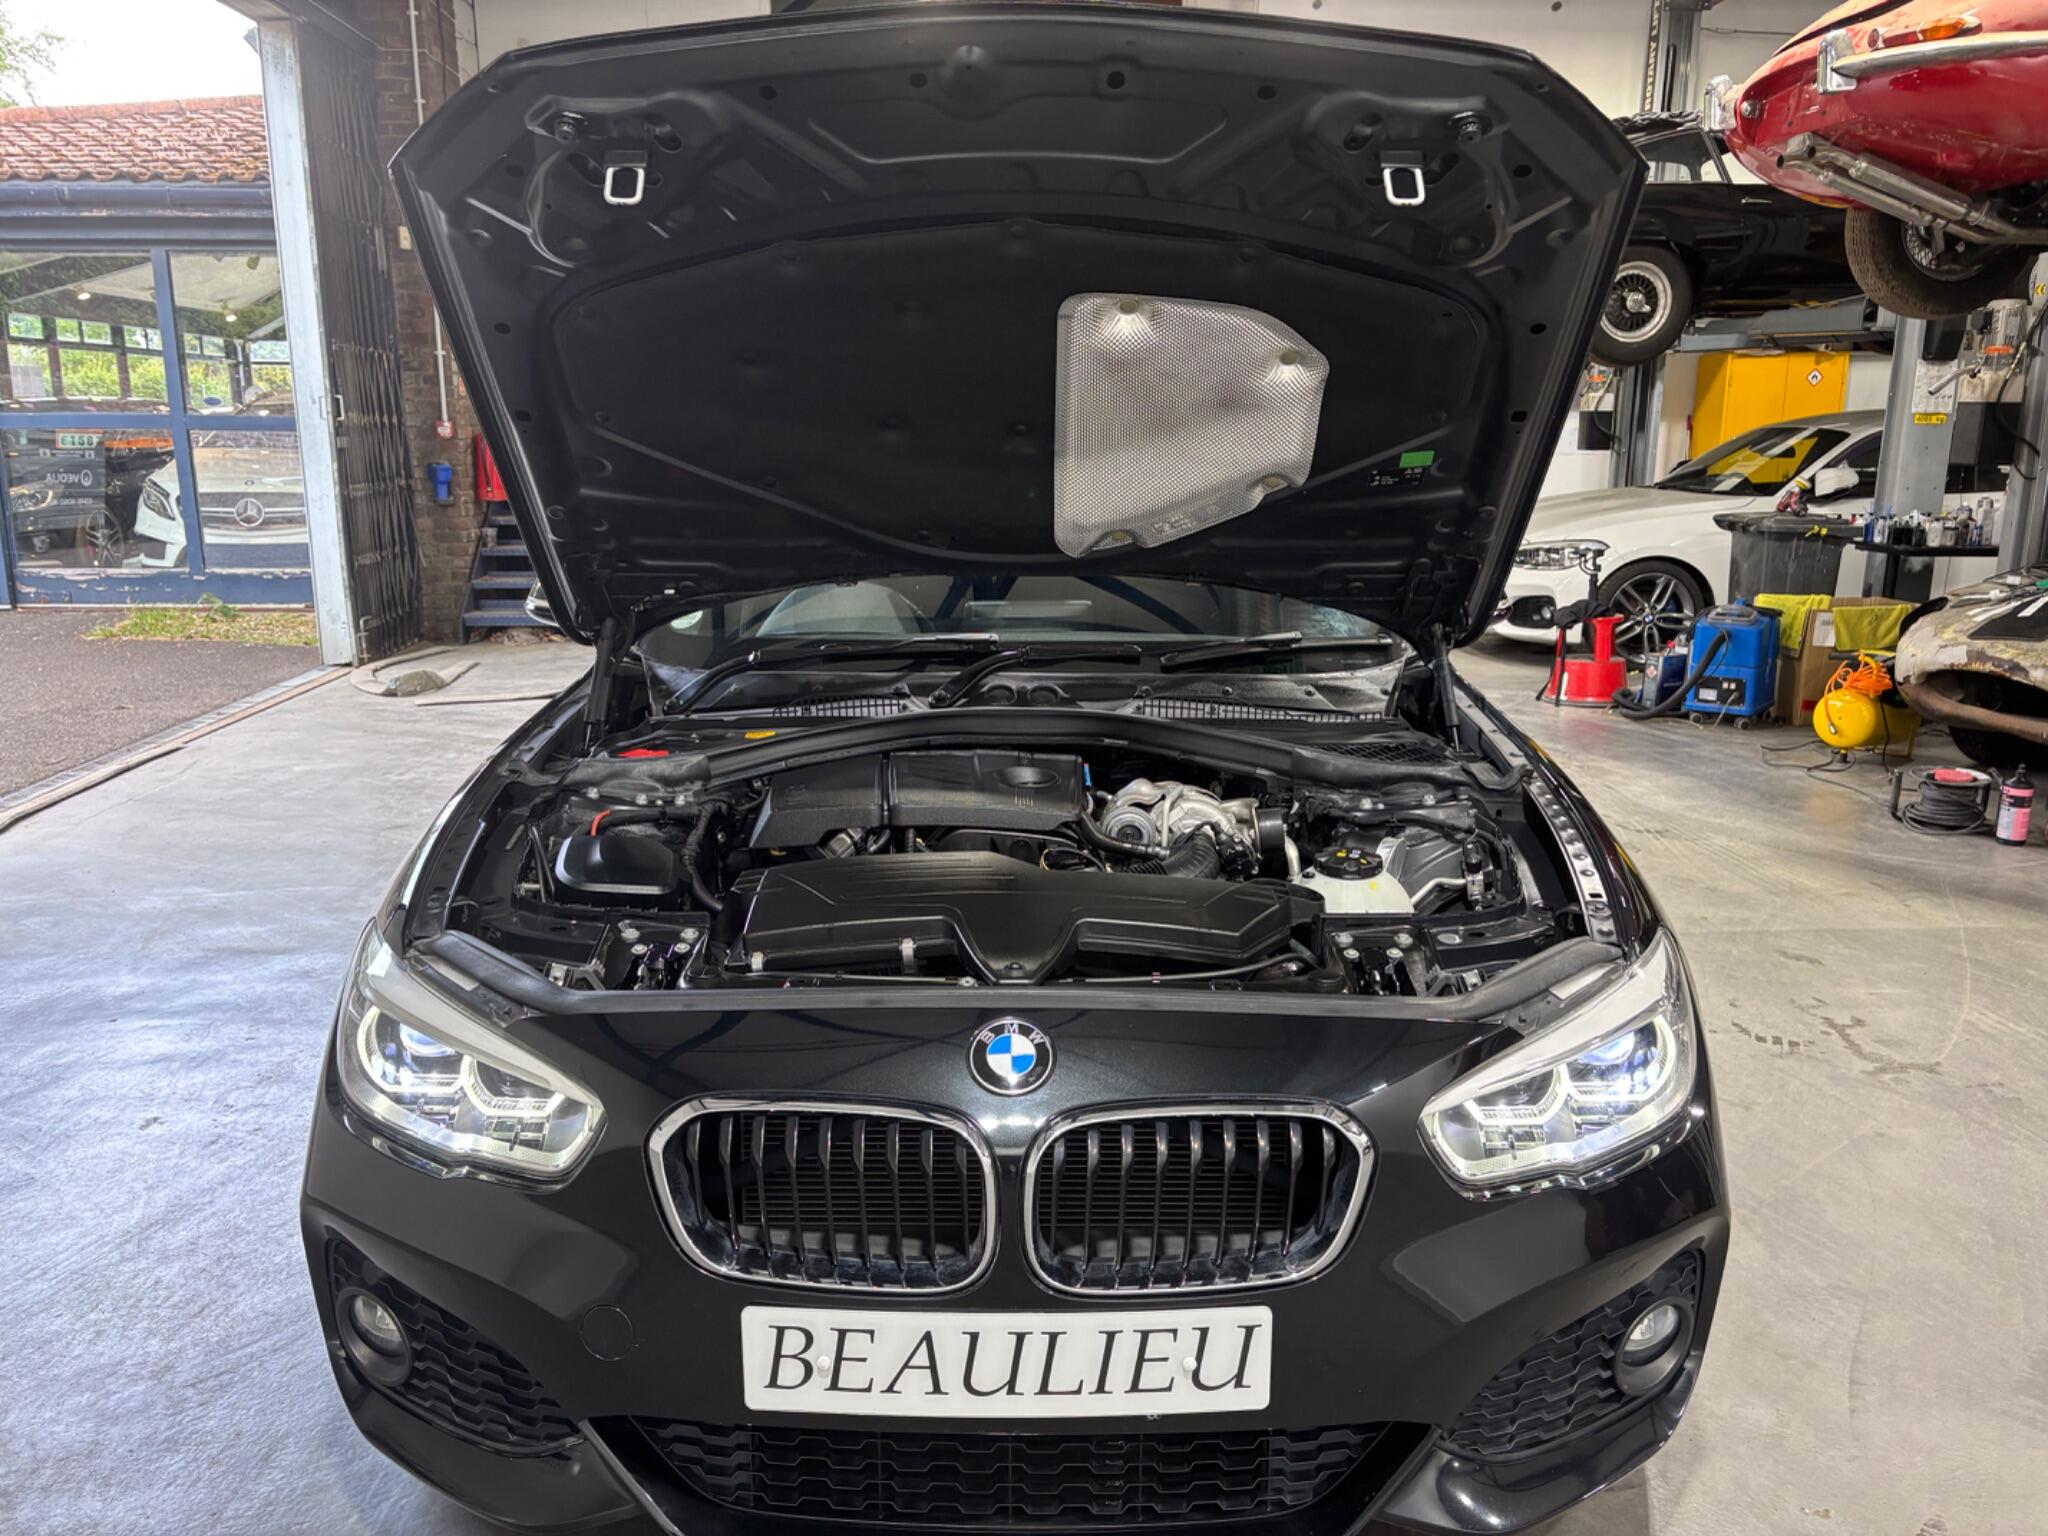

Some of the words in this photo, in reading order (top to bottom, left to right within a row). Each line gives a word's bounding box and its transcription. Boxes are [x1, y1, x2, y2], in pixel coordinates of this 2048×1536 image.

[1644, 41, 1656, 112] ROTARY
[980, 1023, 1044, 1045] BMW
[764, 1324, 1262, 1397] BEAULIEU
